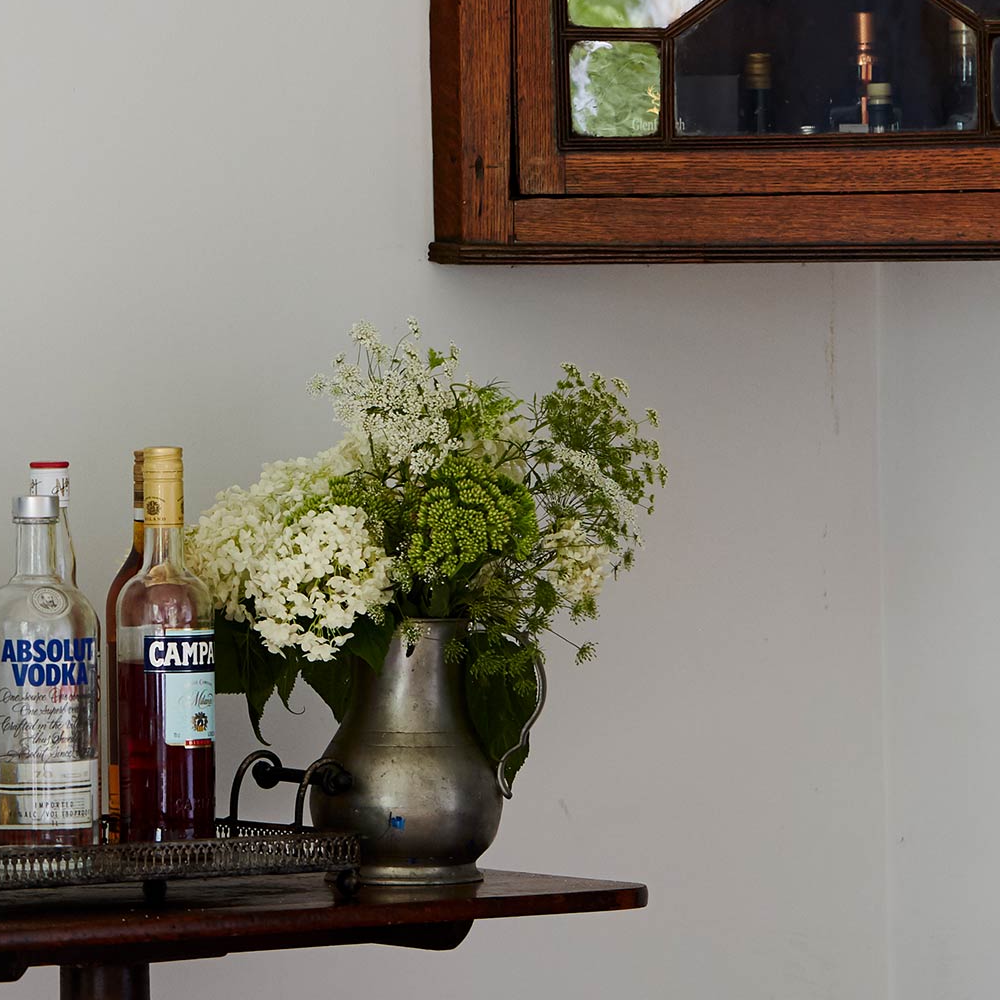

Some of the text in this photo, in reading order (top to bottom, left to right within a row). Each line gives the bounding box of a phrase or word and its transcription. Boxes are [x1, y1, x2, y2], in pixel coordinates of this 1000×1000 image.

[1, 638, 93, 662] ABSOLUT
[12, 663, 88, 687] VODKA
[34, 801, 74, 809] IMPORTED
